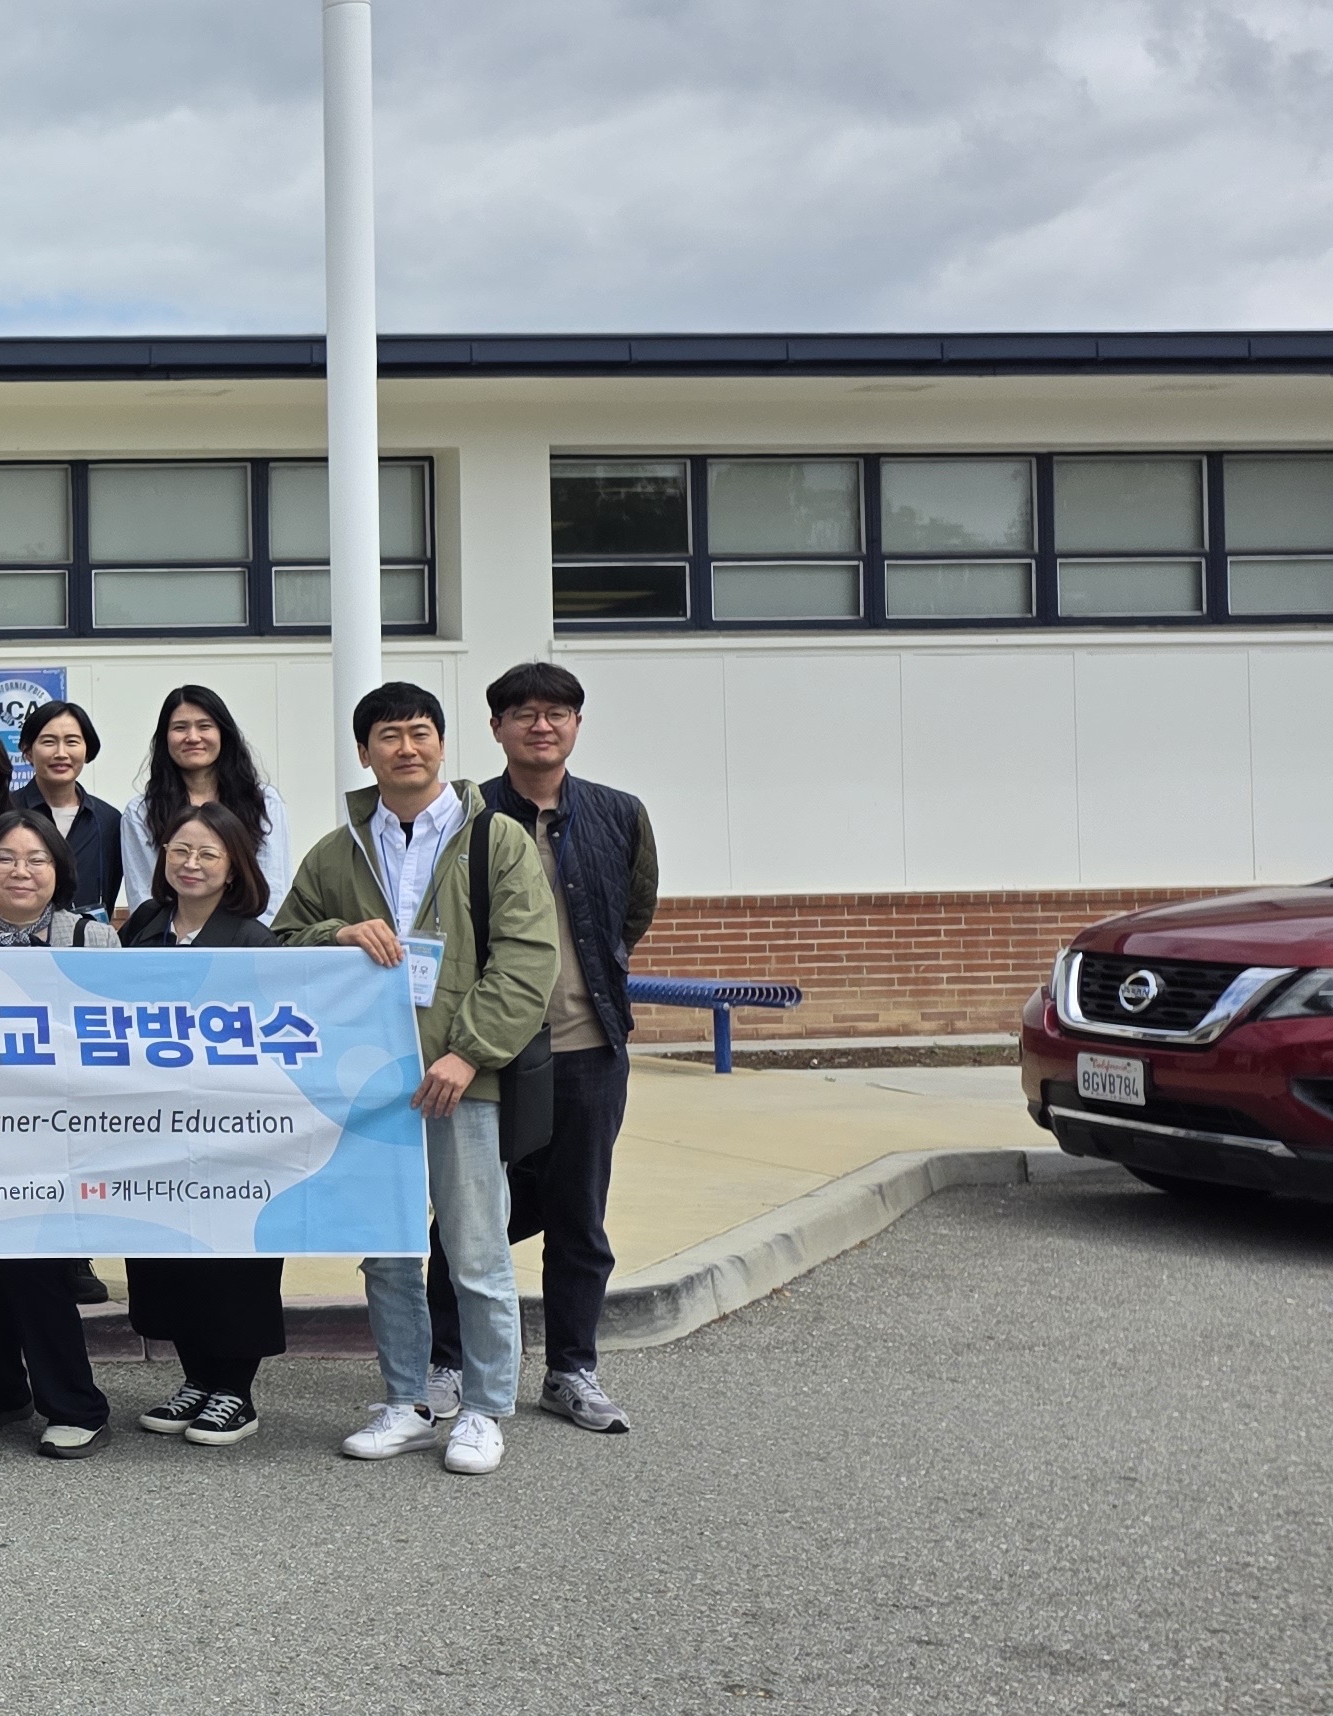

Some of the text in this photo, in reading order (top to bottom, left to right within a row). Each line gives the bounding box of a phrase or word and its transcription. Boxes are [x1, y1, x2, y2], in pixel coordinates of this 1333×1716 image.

[73, 1005, 318, 1068] 탐방연수
[1082, 1070, 1139, 1099] 8GVB784
[171, 1108, 294, 1134] Education
[111, 1179, 272, 1204] 캐나다(Canada)
